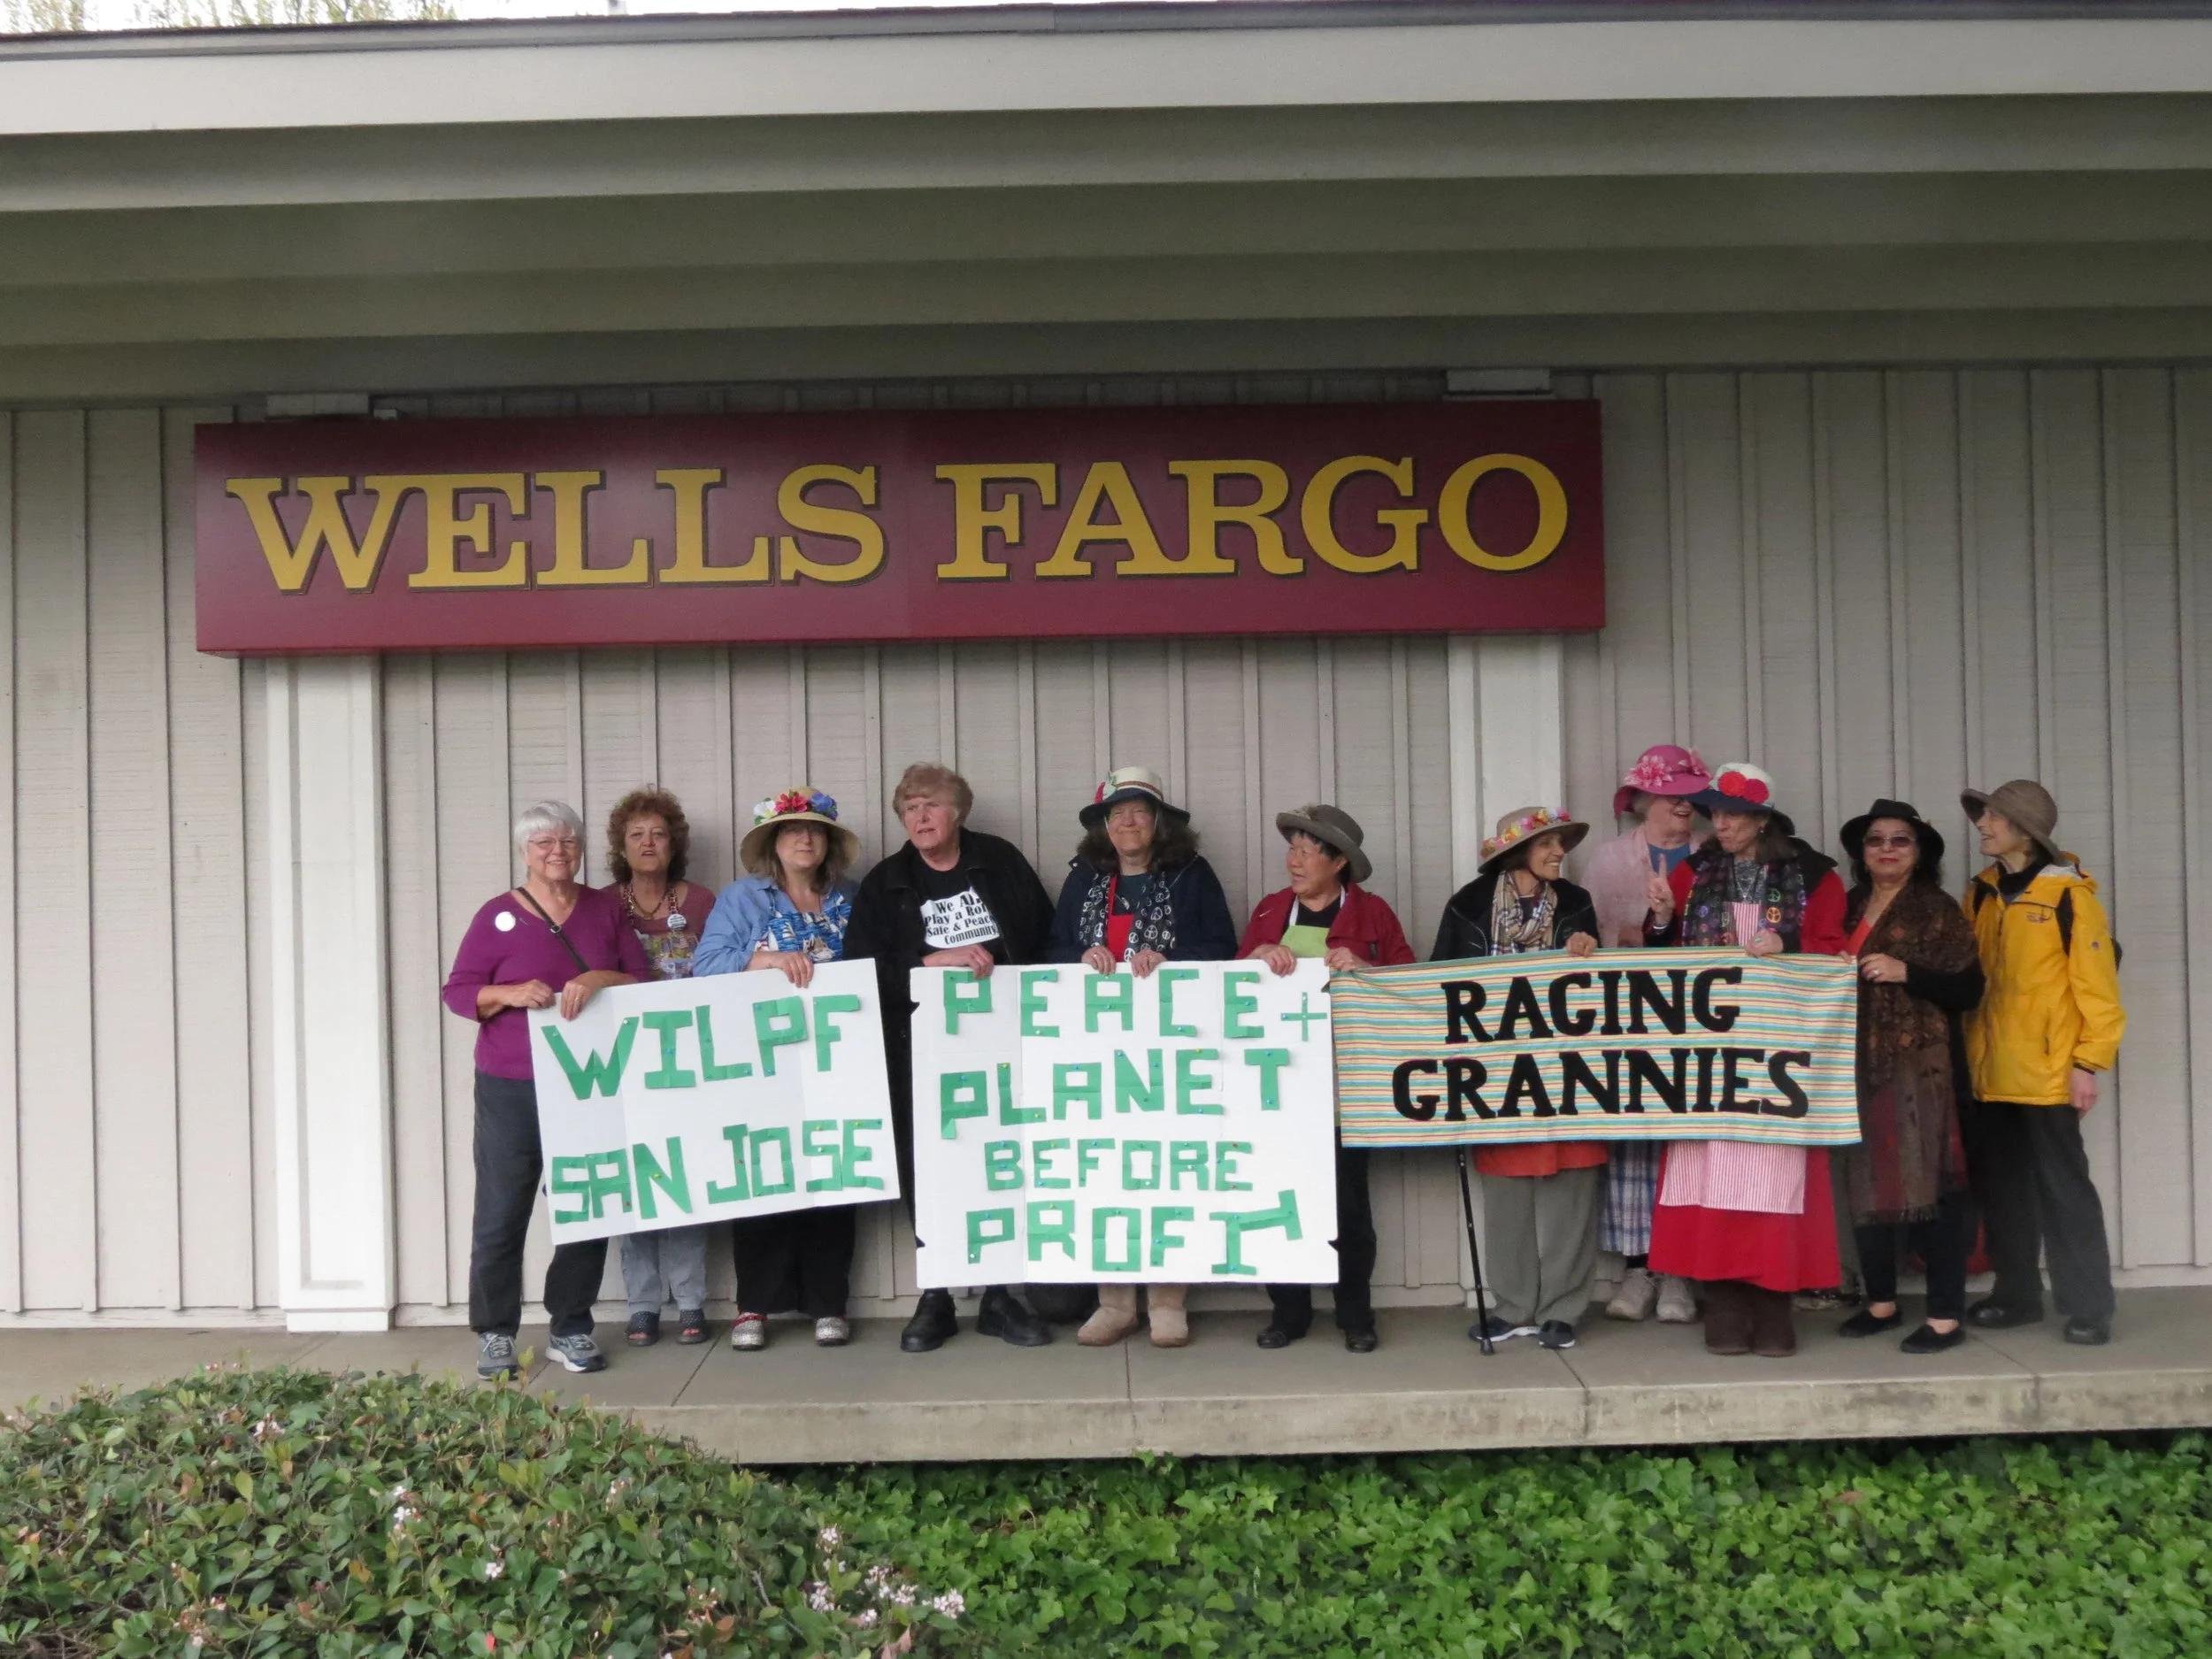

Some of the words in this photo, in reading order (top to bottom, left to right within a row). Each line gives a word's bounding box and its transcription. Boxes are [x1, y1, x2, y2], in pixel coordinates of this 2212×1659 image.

[227, 464, 887, 595] WELLS
[935, 453, 1569, 581] FARGO
[925, 914, 950, 927] Play
[955, 911, 963, 920] a
[965, 903, 987, 917] Rol
[926, 926, 950, 937] Safe
[953, 922, 961, 932] &
[964, 915, 992, 928] Peac
[934, 901, 955, 914] We
[1440, 967, 1742, 1044] RAGING
[541, 995, 862, 1101] WILPF
[1392, 1048, 1811, 1122] GRANNIES
[941, 1048, 1290, 1140] PLANET
[551, 1136, 694, 1224] SAN
[706, 1118, 884, 1204] JOSE
[984, 1138, 1253, 1191] BEFORE
[966, 1189, 1303, 1275] PROFIT
